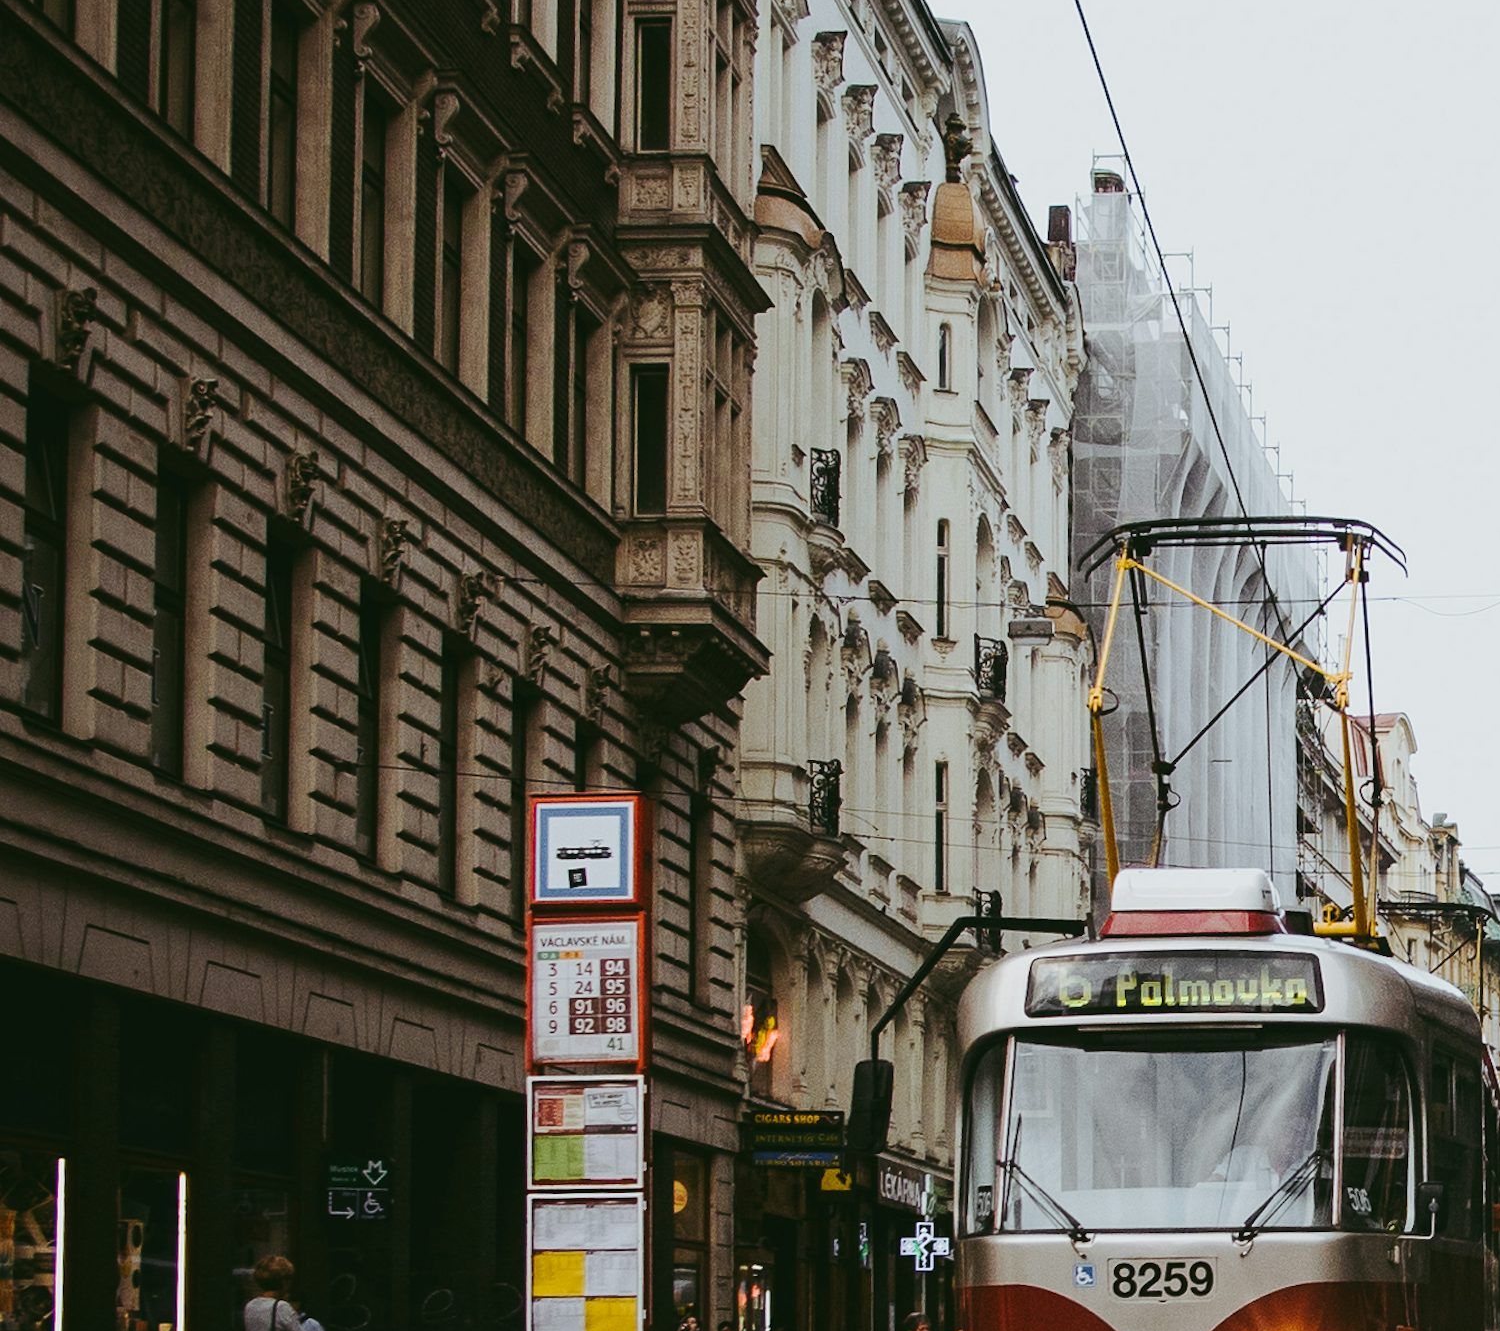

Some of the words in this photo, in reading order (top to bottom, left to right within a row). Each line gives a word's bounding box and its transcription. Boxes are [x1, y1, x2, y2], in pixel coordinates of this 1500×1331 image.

[539, 935, 598, 947] VÁCLAVSKÉ
[548, 963, 558, 977] 3
[576, 962, 593, 976] 14
[605, 960, 625, 975] 94
[548, 982, 558, 996] 5
[575, 981, 593, 995] 24
[605, 979, 625, 994] 95
[1115, 965, 1308, 1008] Palmovka
[548, 1000, 558, 1015] 6
[574, 999, 594, 1014] 91
[605, 998, 626, 1013] 96
[548, 1019, 558, 1033] 9
[574, 1018, 595, 1033] 92
[606, 1018, 626, 1033] 98
[606, 1037, 625, 1051] 41
[754, 1114, 791, 1125] CIGARS
[793, 1114, 820, 1125] SHOP
[1347, 1186, 1373, 1213] 506
[1112, 1261, 1215, 1300] 8259
